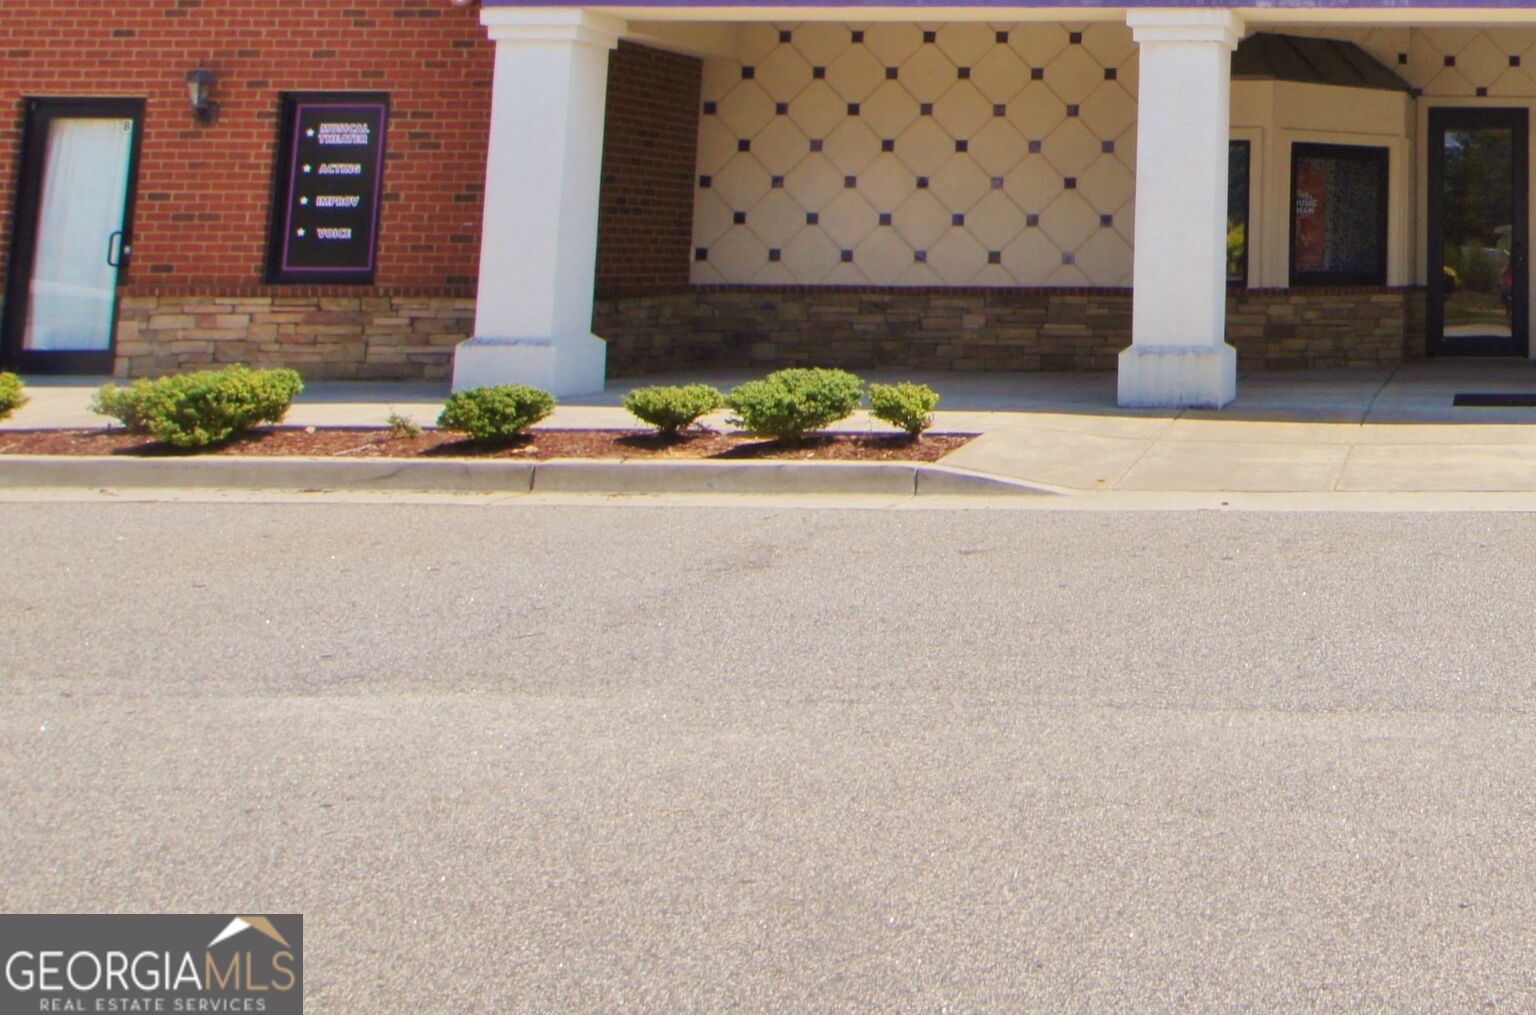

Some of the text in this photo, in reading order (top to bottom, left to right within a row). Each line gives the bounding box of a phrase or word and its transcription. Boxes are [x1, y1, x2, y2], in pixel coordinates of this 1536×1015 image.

[319, 122, 370, 134] MUSICAL
[318, 133, 368, 144] THEATER
[318, 163, 362, 175] ACTING
[316, 195, 360, 207] IMPROV
[317, 228, 352, 239] VOICE
